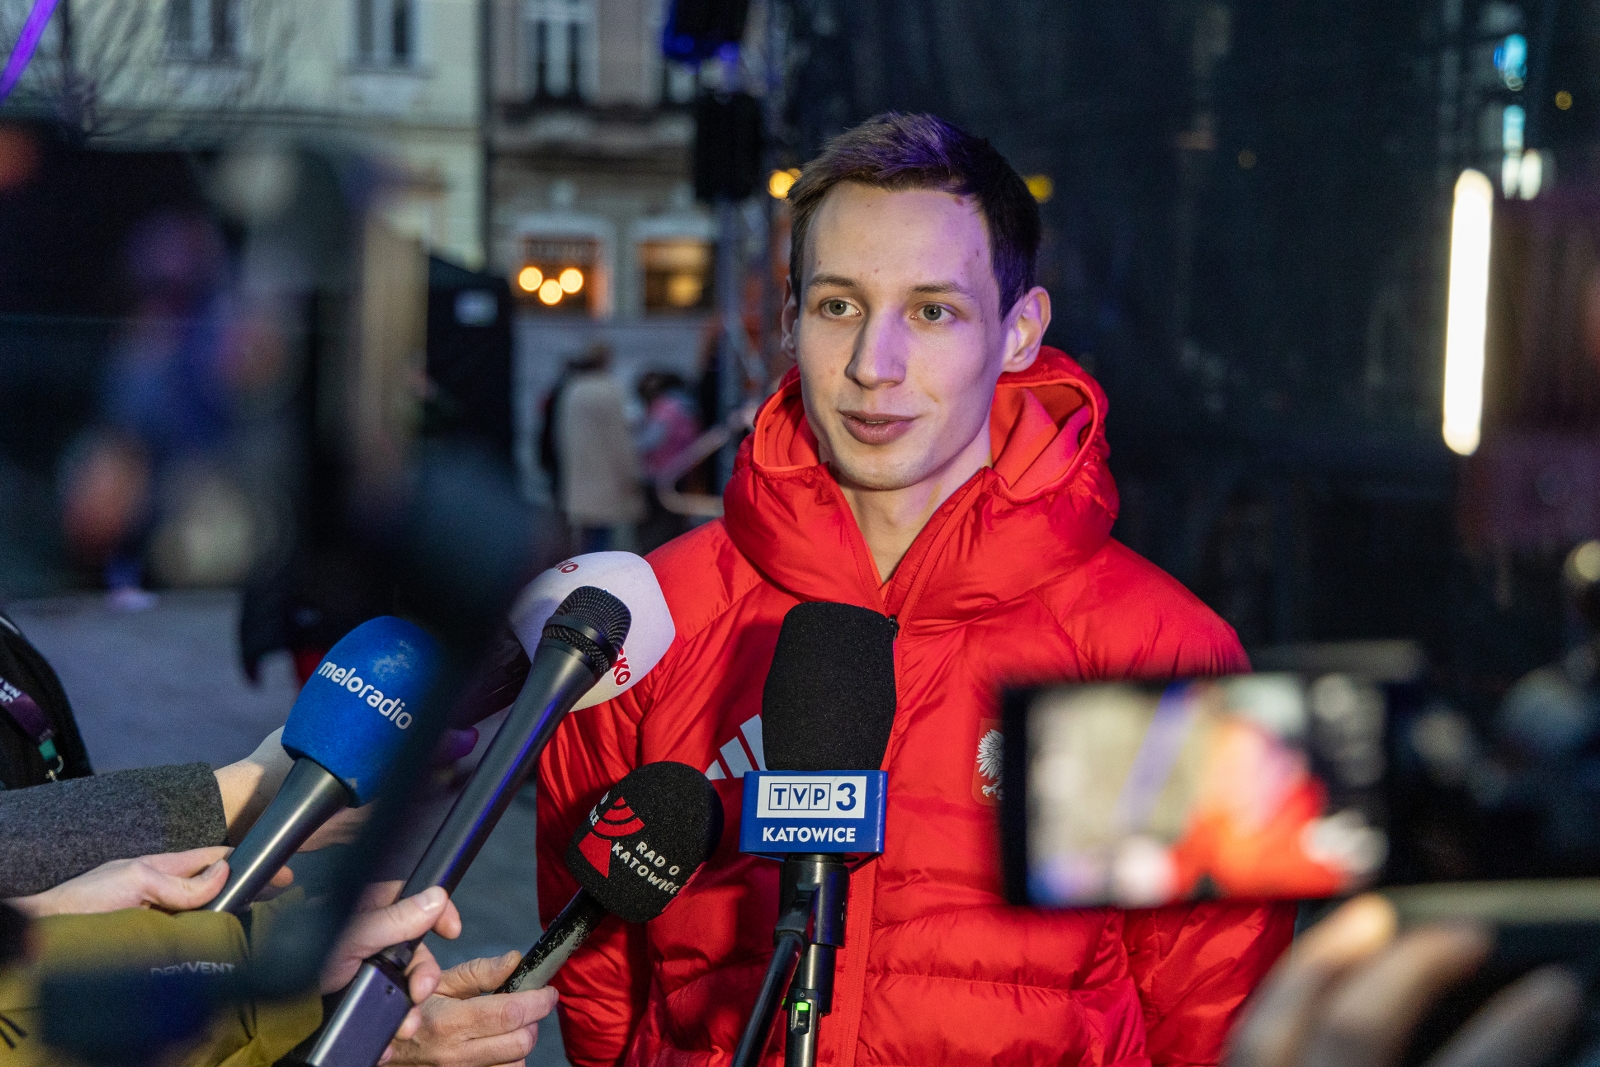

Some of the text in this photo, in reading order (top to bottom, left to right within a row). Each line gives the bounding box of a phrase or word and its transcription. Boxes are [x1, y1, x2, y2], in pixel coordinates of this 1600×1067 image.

[612, 648, 632, 686] KO
[318, 661, 412, 730] meloradio
[773, 782, 857, 811] TVP 3
[762, 827, 856, 843] KATOWICE
[612, 842, 680, 895] KATOWICE
